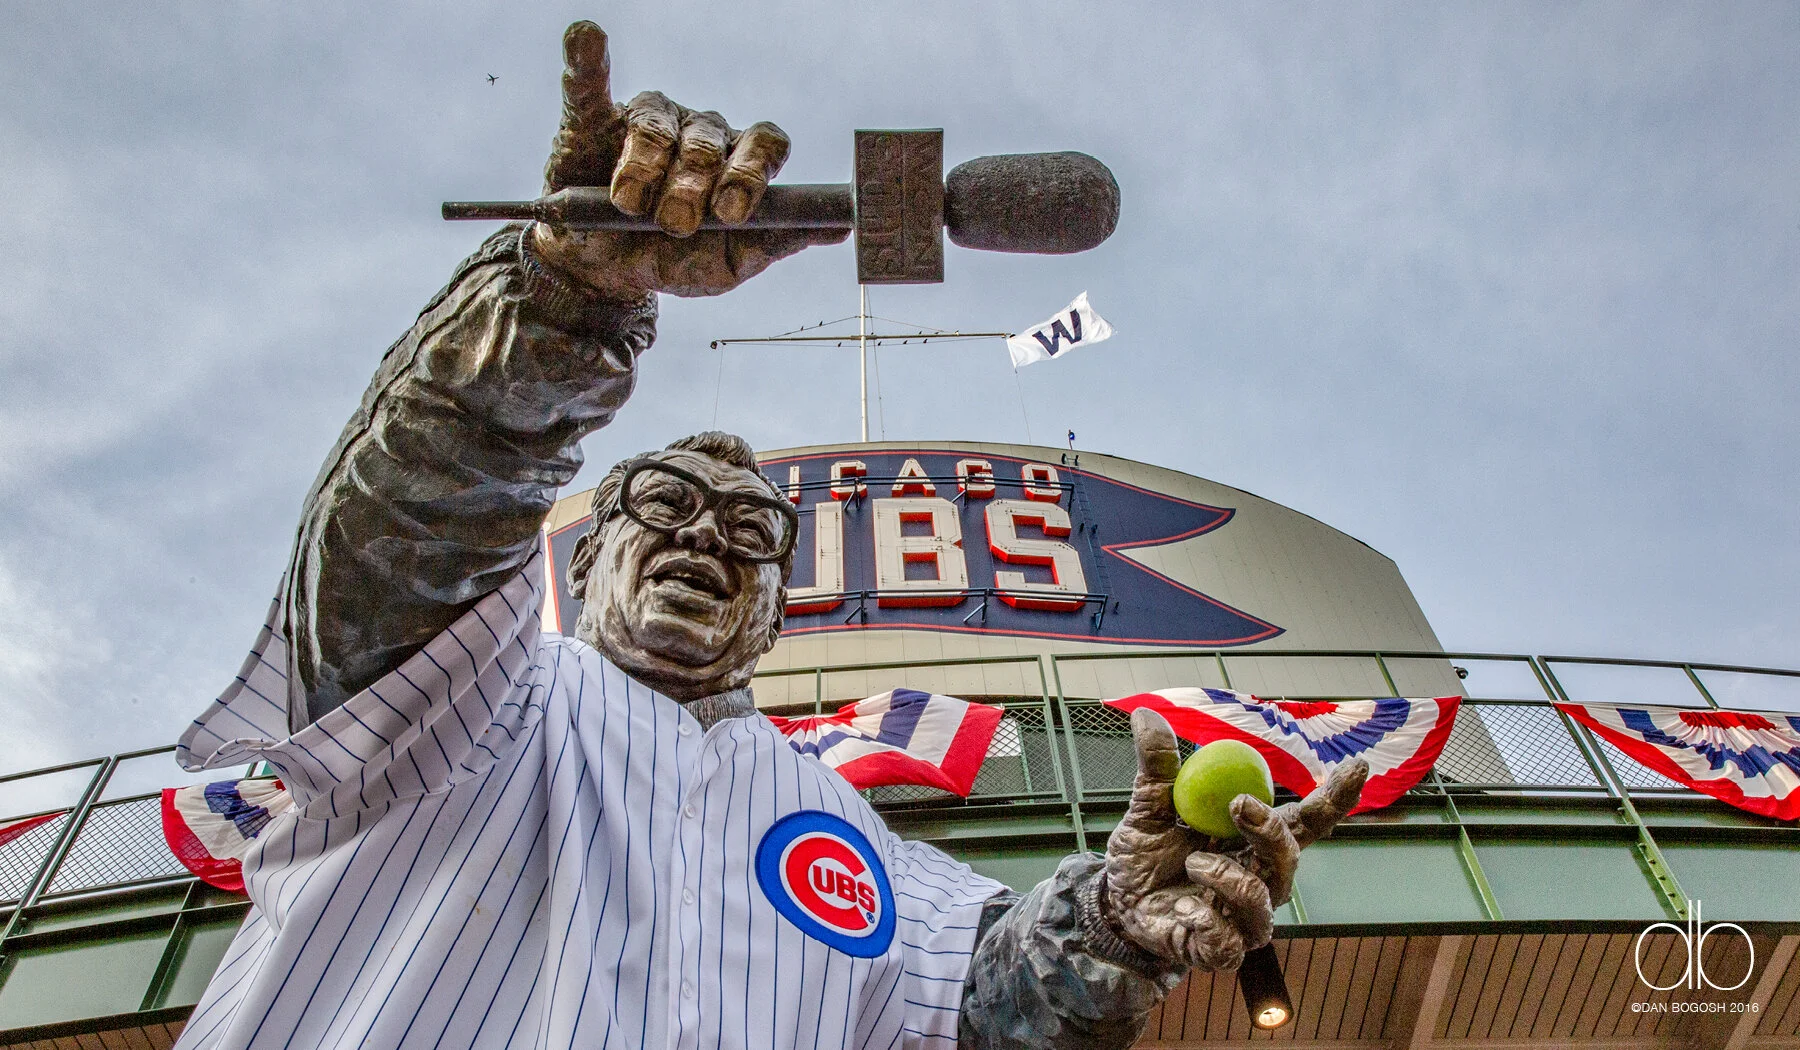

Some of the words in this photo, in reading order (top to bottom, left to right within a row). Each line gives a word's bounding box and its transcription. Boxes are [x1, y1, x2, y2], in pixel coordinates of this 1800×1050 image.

[1032, 308, 1082, 356] W
[788, 457, 1063, 505] ICAGO
[786, 497, 1088, 613] UBS
